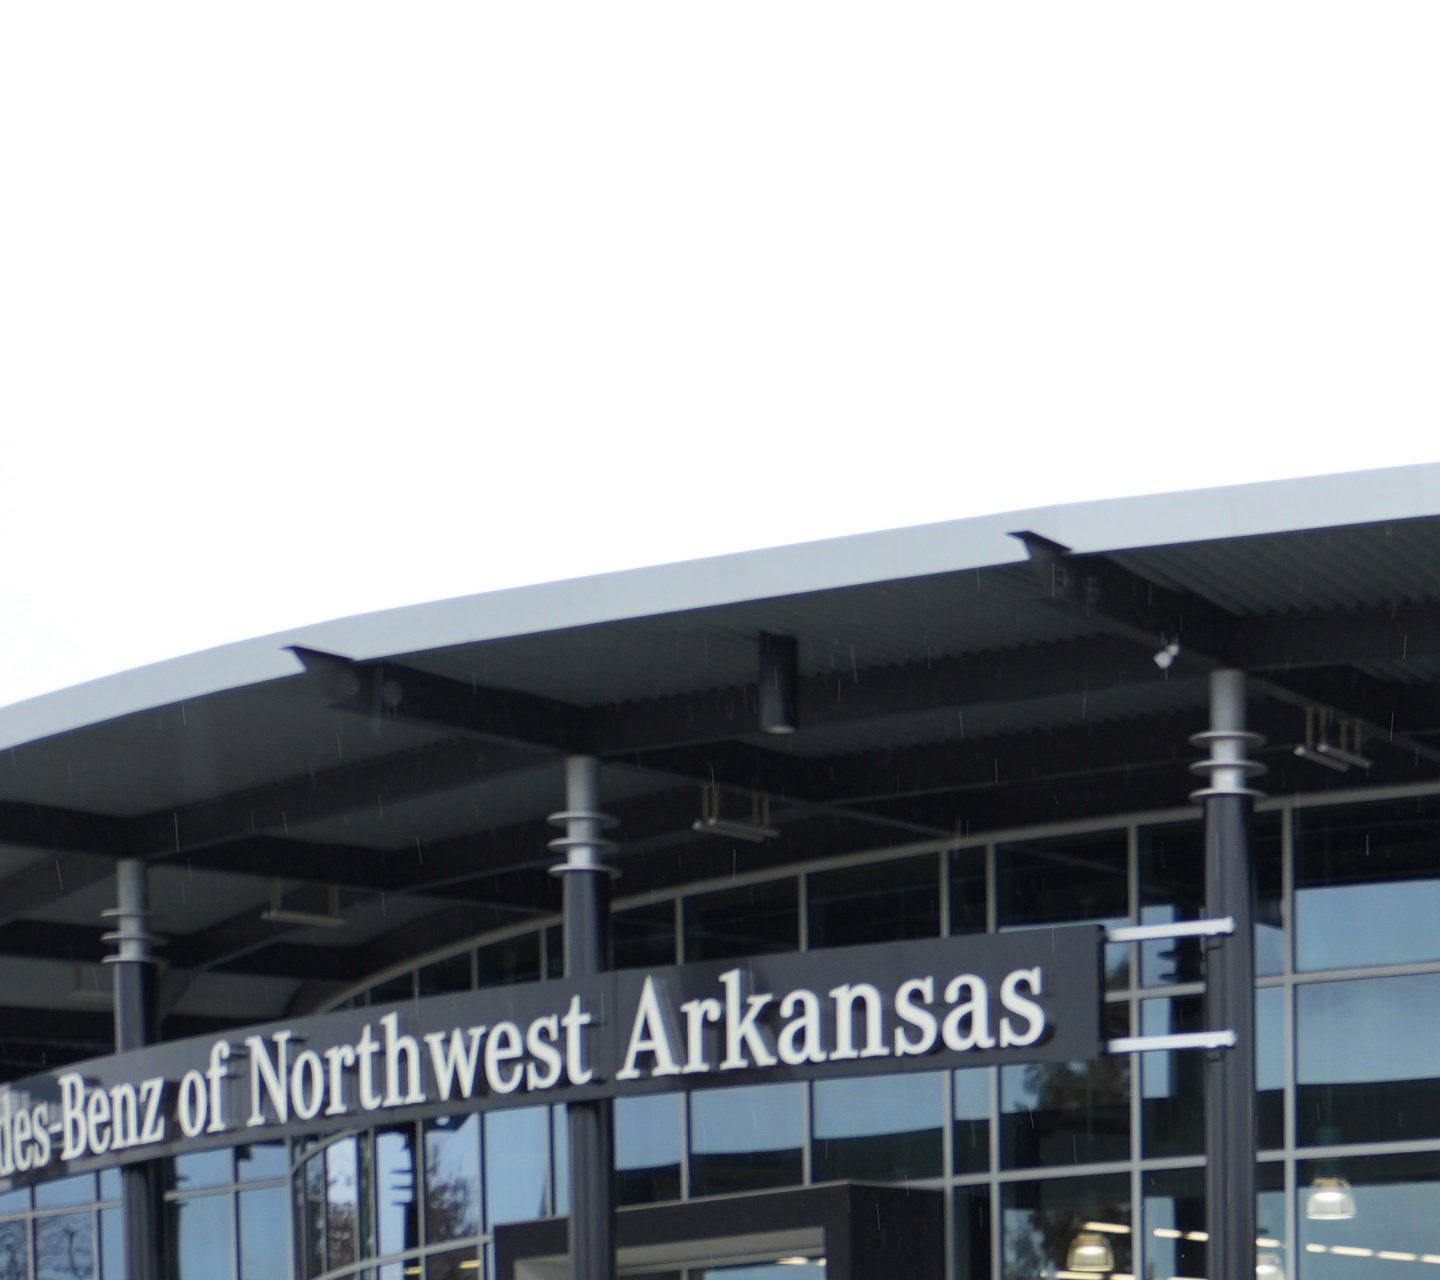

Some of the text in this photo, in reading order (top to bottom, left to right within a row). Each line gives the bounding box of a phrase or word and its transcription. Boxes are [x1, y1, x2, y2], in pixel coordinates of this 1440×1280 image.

[178, 1039, 231, 1138] of
[245, 995, 593, 1128] Northwest
[616, 965, 1047, 1081] Arkansas
